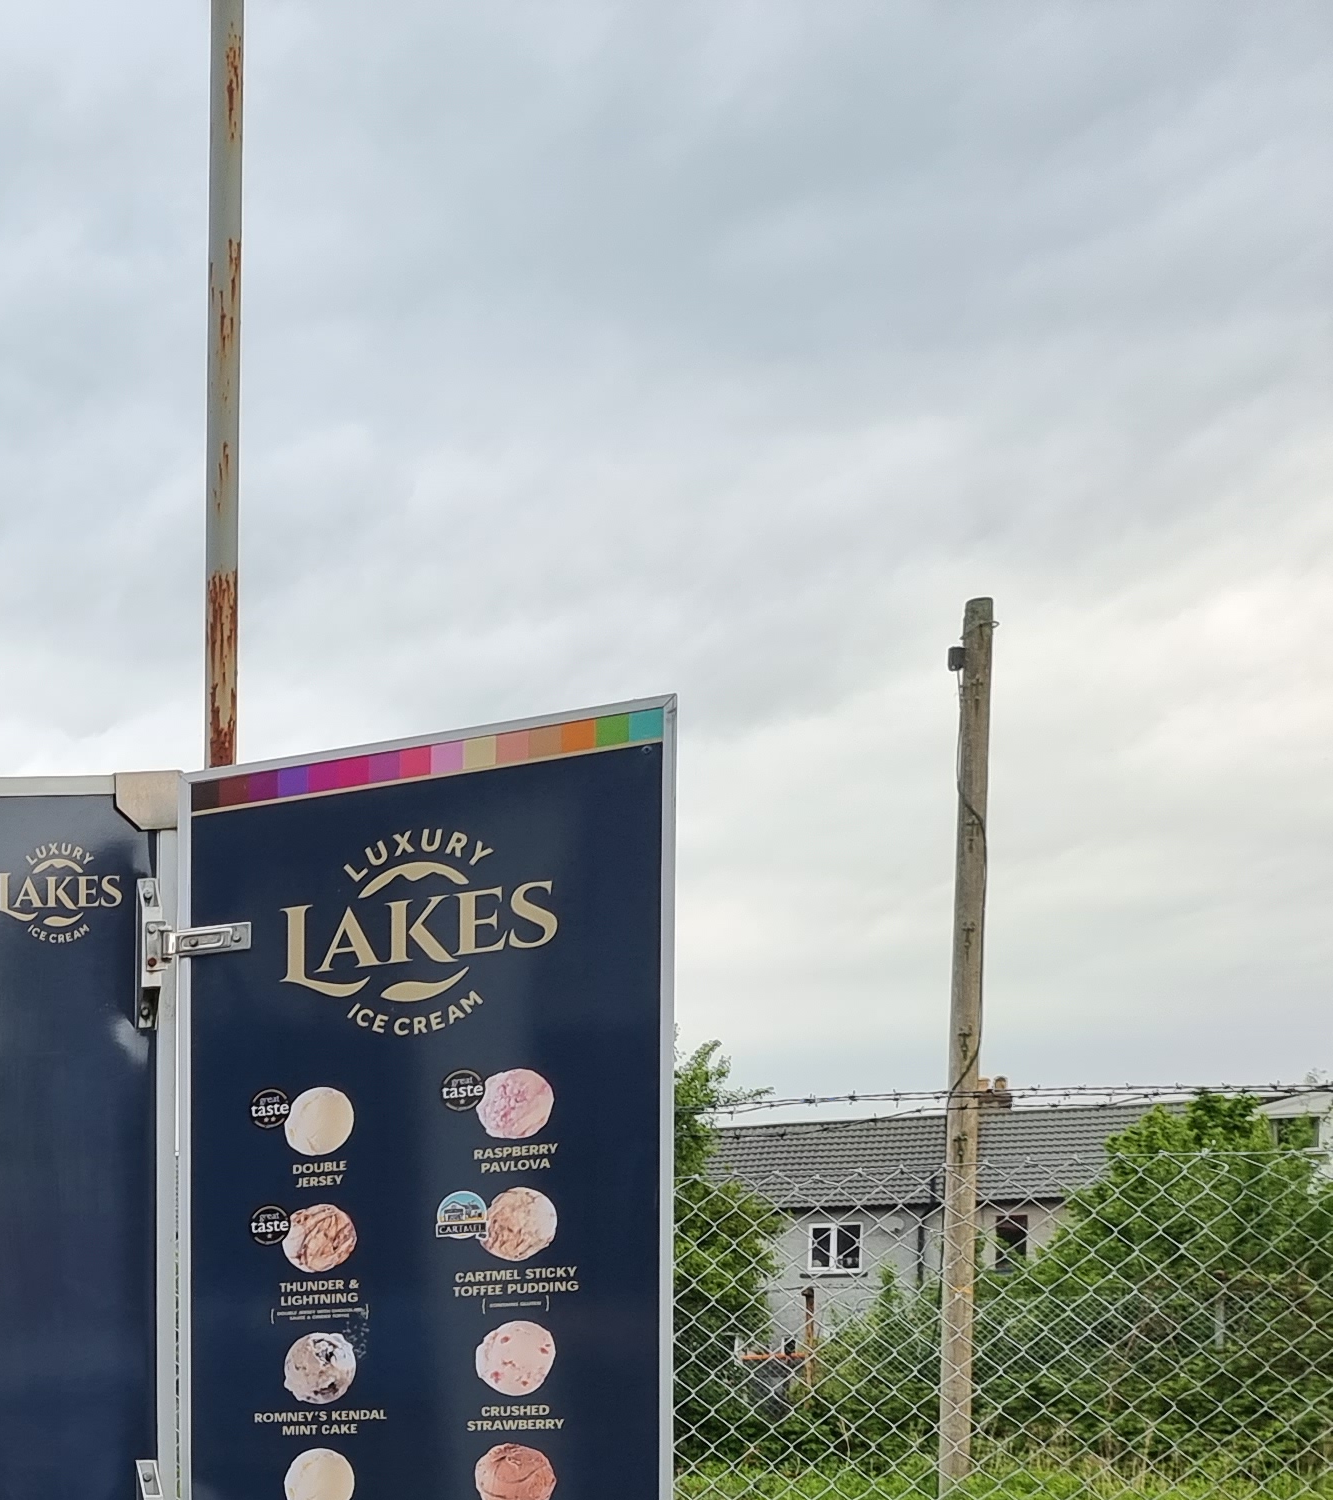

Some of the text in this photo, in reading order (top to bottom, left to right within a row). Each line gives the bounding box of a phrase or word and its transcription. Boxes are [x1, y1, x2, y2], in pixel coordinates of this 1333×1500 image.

[25, 842, 94, 865] LUXURY
[343, 828, 494, 882] LUXURY
[27, 924, 90, 943] ICE CREAM
[279, 880, 559, 998] LAKES
[347, 990, 484, 1036] ICE CREAM
[442, 1084, 483, 1099] taste
[260, 1096, 280, 1104] great
[251, 1102, 289, 1117] taste
[473, 1142, 559, 1160] RASPBERRY
[292, 1161, 347, 1175] DOUBLE
[481, 1158, 551, 1173] PAVLOVA
[296, 1175, 343, 1188] JERSEY
[260, 1212, 280, 1222] great
[251, 1220, 289, 1233] taste
[455, 1266, 577, 1283] CARTMEL STICKY
[279, 1279, 359, 1293] THUNDER &
[453, 1281, 579, 1297] TOFFEE PUDDING
[281, 1293, 358, 1306] LIGHTNING
[331, 1410, 387, 1420] KENDAL
[481, 1405, 550, 1417] CRUSHED
[282, 1424, 358, 1436] MINT CAKE
[467, 1419, 565, 1431] STRAWBERRY
